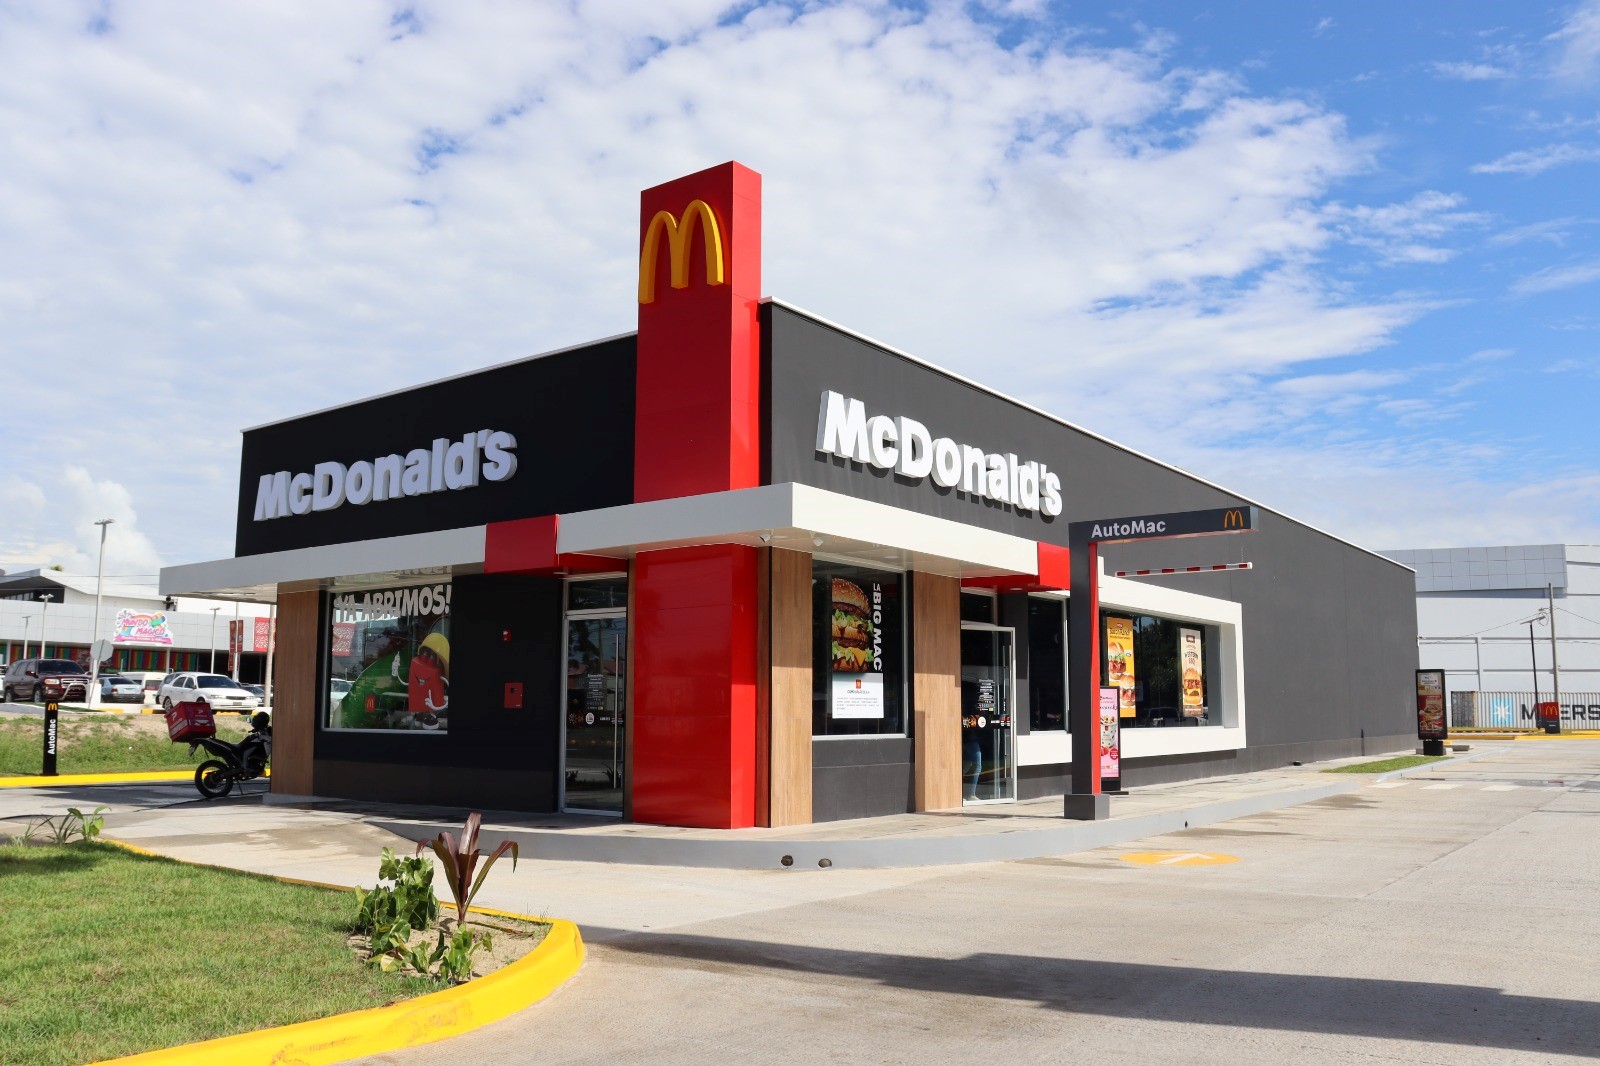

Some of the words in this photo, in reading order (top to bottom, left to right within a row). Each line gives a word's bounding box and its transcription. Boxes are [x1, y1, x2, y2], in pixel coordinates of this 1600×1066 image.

[816, 390, 1062, 516] McDonald's
[254, 429, 517, 521] McDonald's
[1091, 520, 1167, 538] AutoMac
[363, 585, 452, 622] ABRIMOS!
[873, 592, 882, 625] BIG
[873, 628, 882, 671] MAC
[1522, 703, 1600, 720] MERS
[47, 719, 56, 755] AutoMac
